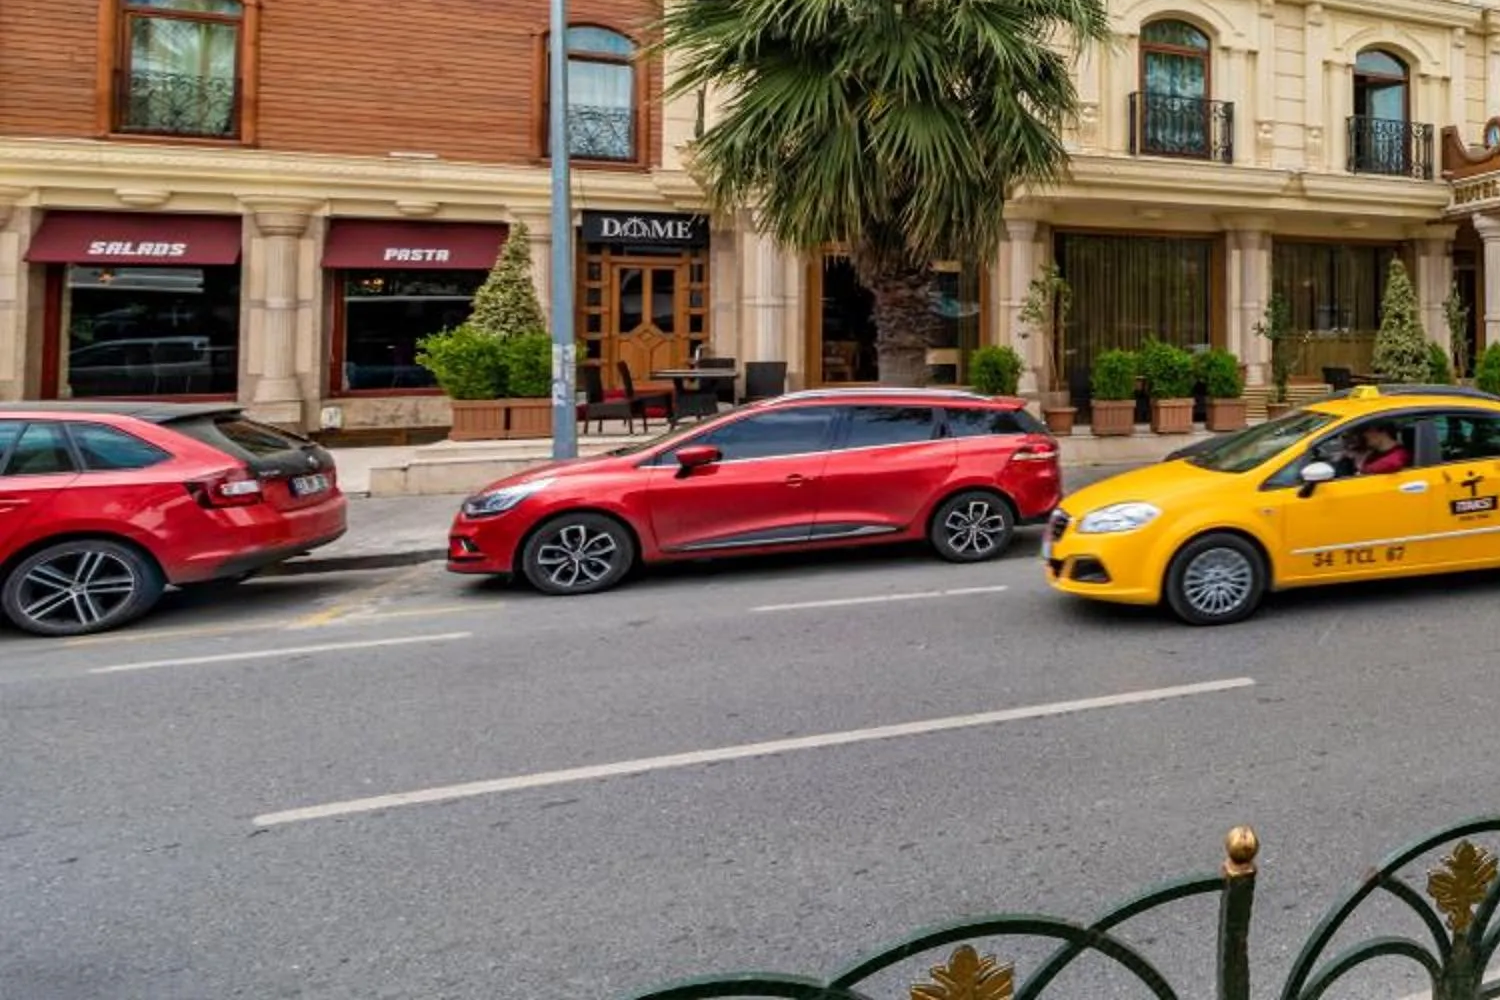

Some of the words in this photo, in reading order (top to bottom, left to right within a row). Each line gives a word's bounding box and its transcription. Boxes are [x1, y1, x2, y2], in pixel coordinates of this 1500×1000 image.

[88, 241, 187, 257] SALADS
[384, 248, 449, 261] PASTA
[1312, 551, 1334, 567] 34
